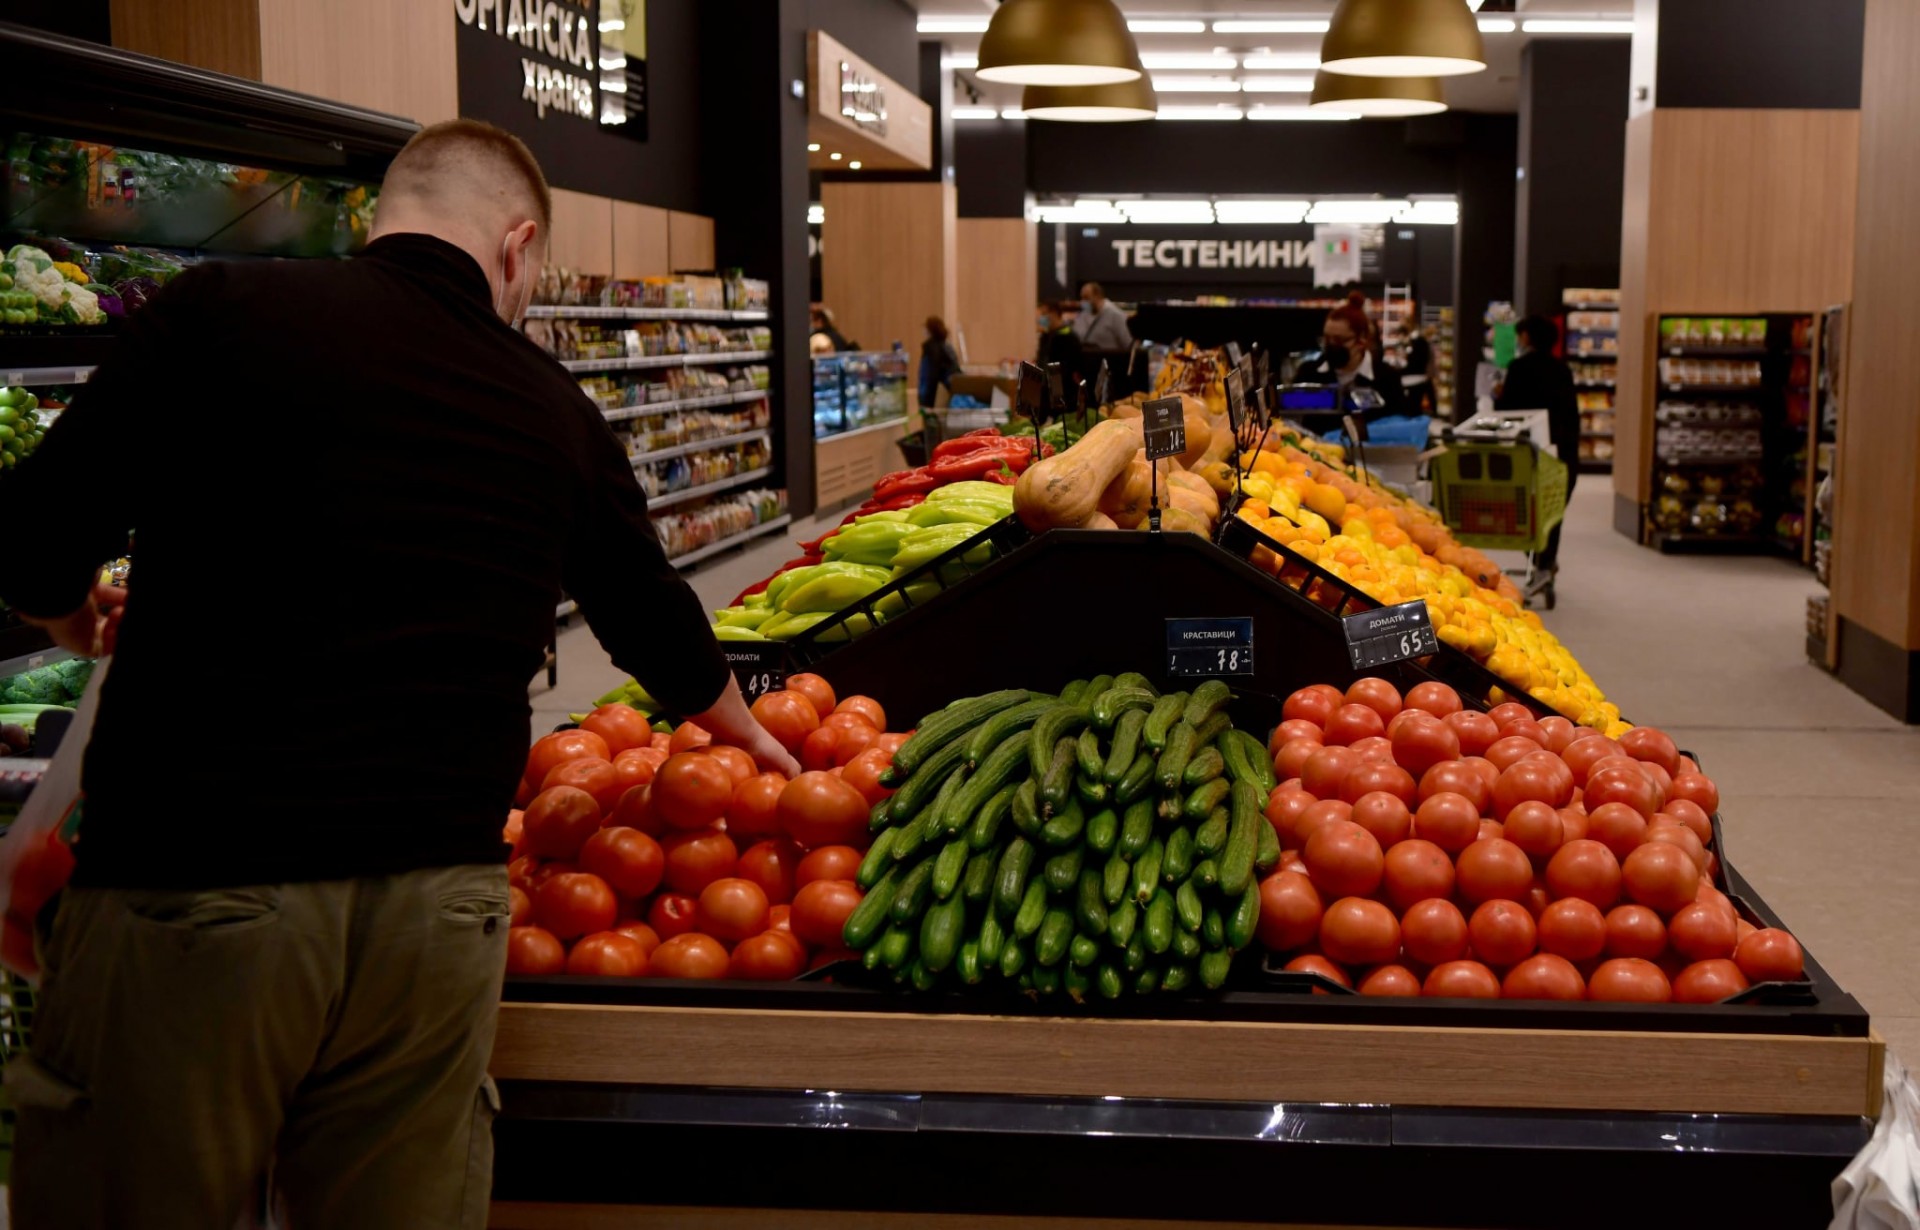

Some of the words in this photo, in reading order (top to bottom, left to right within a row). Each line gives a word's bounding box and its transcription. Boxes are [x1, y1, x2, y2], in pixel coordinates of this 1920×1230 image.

[522, 58, 593, 119] храна
[1111, 239, 1315, 268] ТЕСТЕНИНИ
[1369, 614, 1405, 629] ДОМАТИ
[1183, 631, 1236, 640] КРАСТАВИЦИ
[1400, 631, 1422, 656] 65
[1217, 649, 1239, 671] 78
[748, 673, 770, 695] 49
